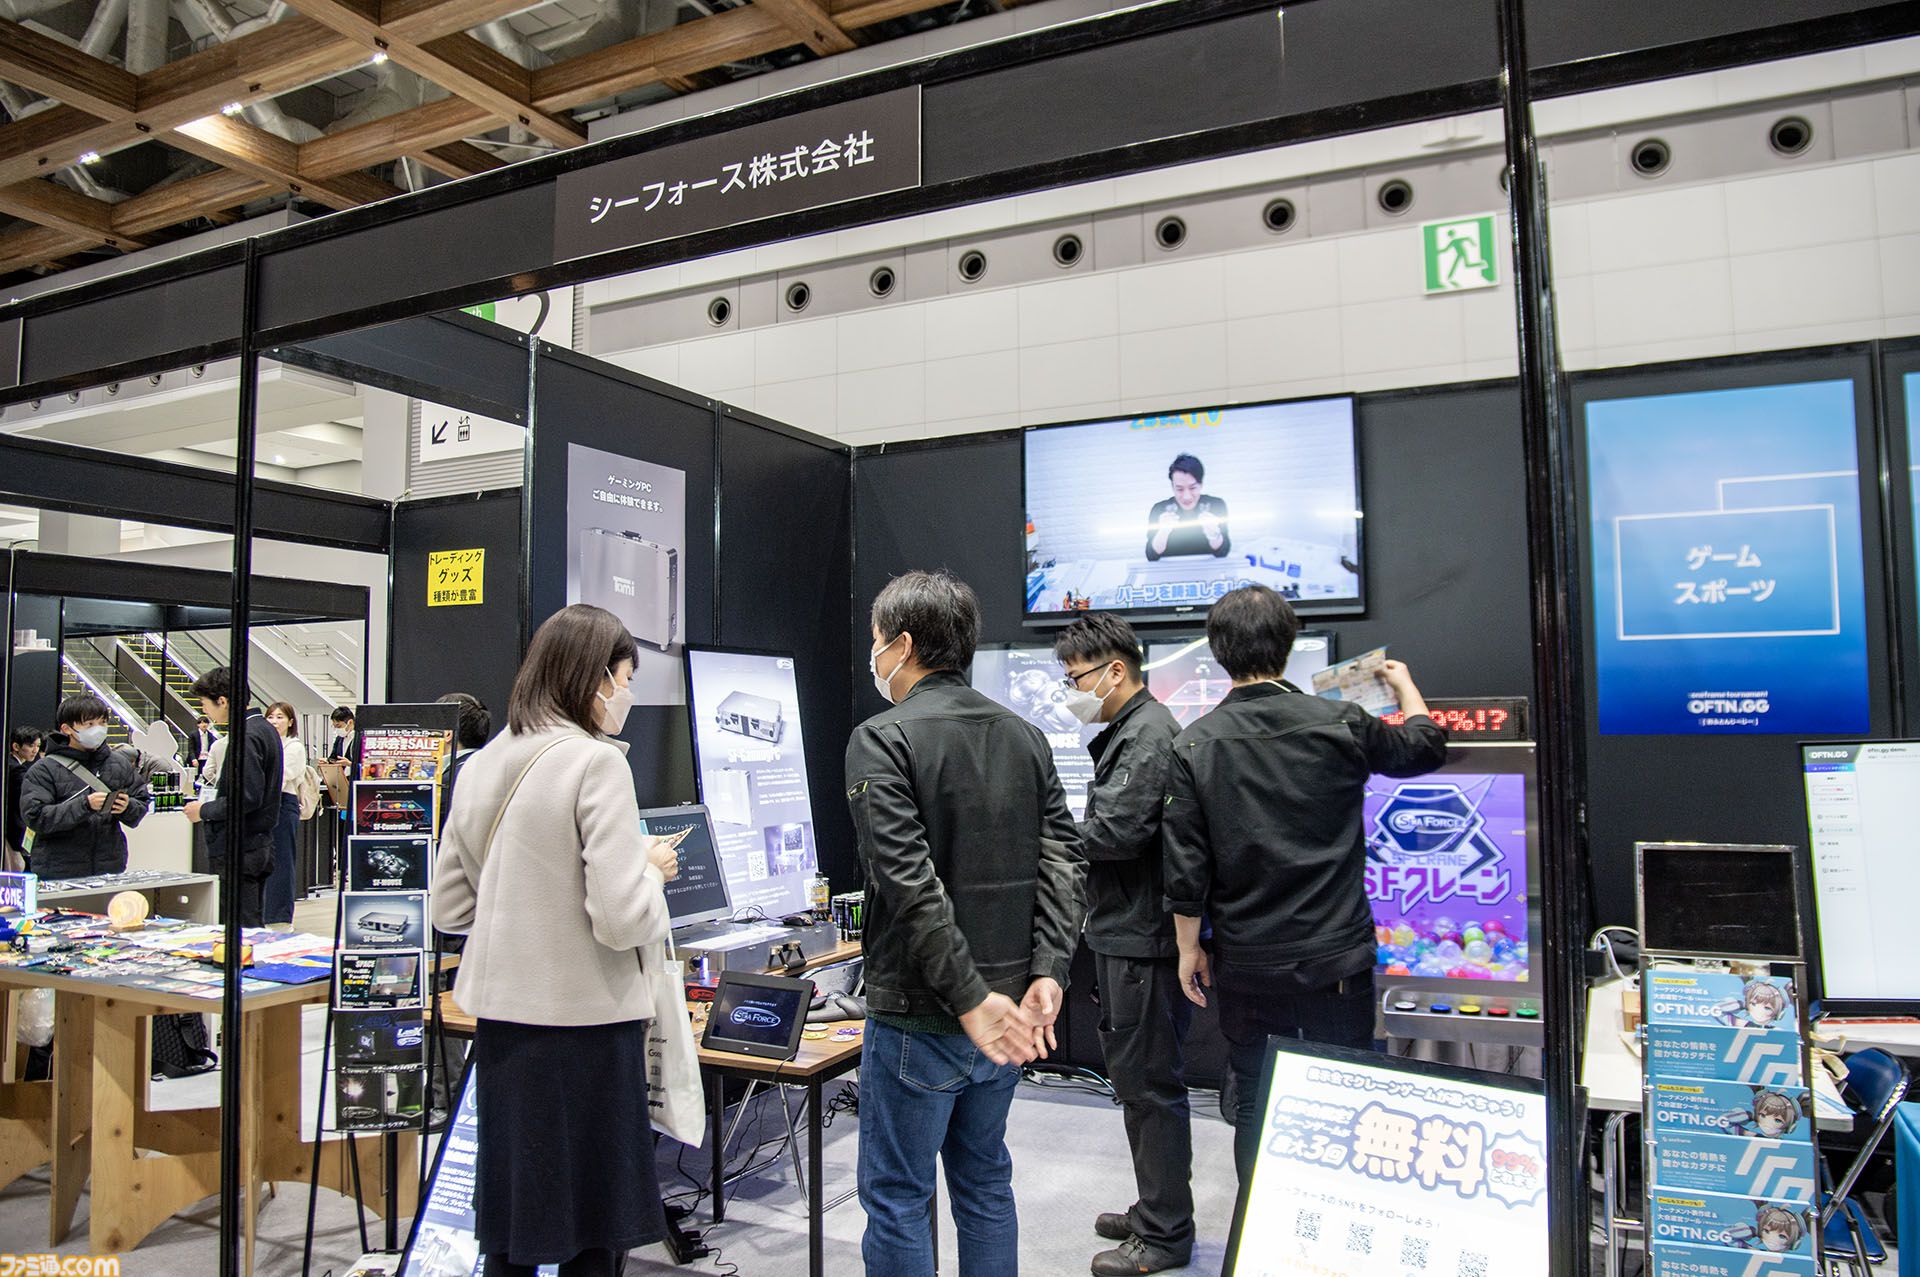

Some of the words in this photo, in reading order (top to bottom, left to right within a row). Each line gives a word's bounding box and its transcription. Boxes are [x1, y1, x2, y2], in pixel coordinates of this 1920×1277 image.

[589, 130, 876, 224] シーフォース株式会社
[607, 474, 652, 493] ゲーミングPC
[592, 488, 663, 513] ご自由に体験できます。
[430, 550, 483, 566] トレーディング
[1685, 545, 1761, 570] ゲーム
[438, 567, 473, 584] グッズ
[433, 589, 477, 602] 種類が豊富
[1673, 578, 1776, 604] スポーツ
[1687, 699, 1770, 714] OFTN.GG
[1046, 732, 1080, 749] OUSE
[1810, 751, 1848, 759] OFTN.GG
[1363, 866, 1505, 906] SFクレーン
[1653, 1002, 1722, 1017] OFTN.GG
[752, 1013, 776, 1024] FORCE
[1654, 1040, 1717, 1051] あなたの情熱を
[1657, 1110, 1730, 1128] OFTN.GG
[1352, 1104, 1484, 1196] 無料
[1662, 1149, 1727, 1162] あなたの情熱を
[1657, 1223, 1733, 1243] OFTN.GG
[1662, 1261, 1728, 1276] あなたの情熱を
